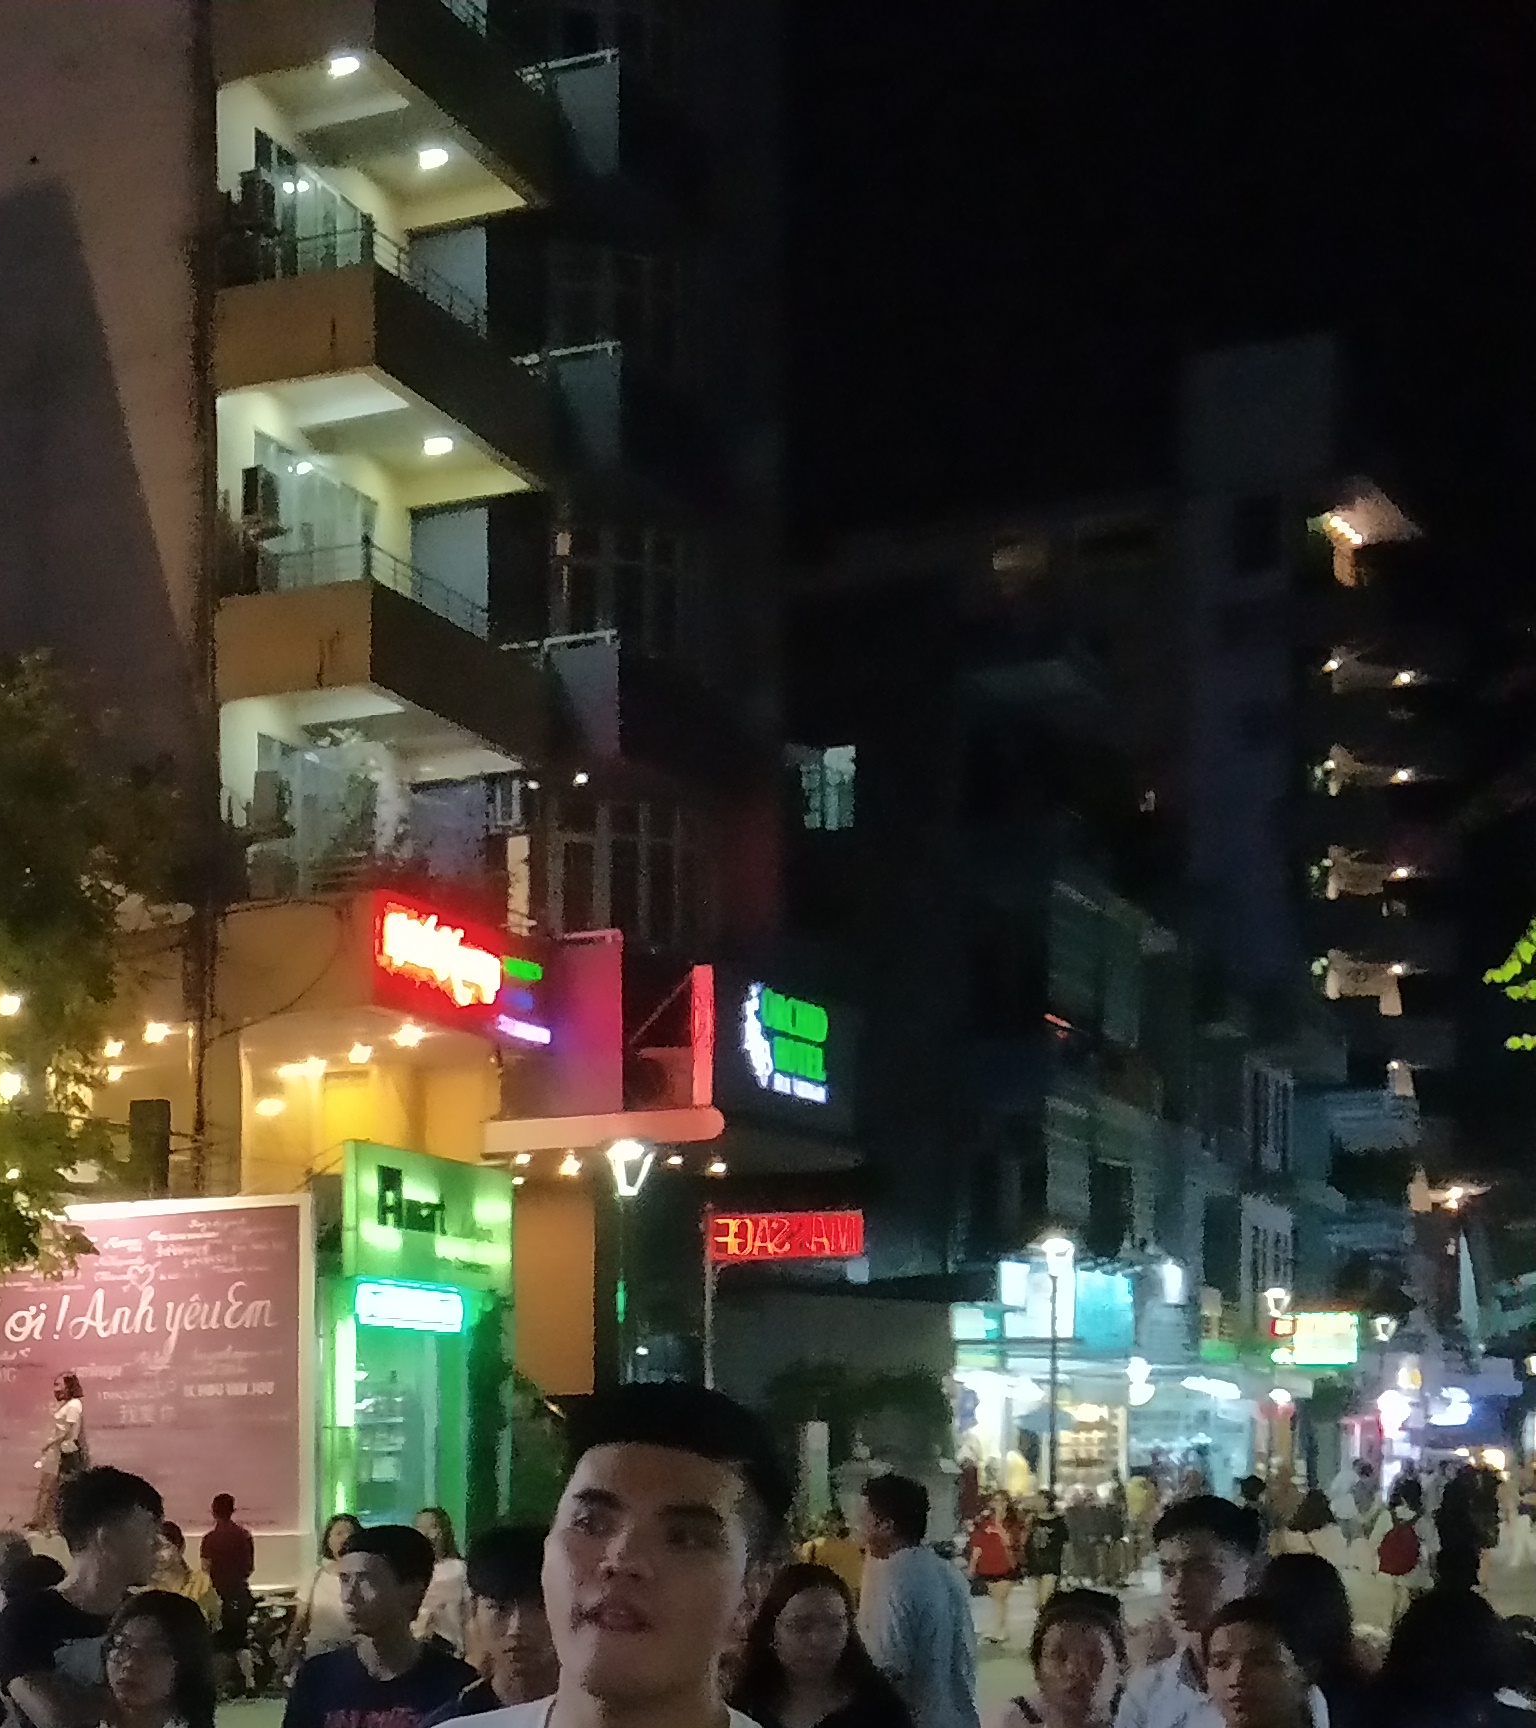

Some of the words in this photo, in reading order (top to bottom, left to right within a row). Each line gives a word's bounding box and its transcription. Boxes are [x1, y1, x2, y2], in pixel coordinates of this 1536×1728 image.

[69, 1284, 157, 1341] Anh
[165, 1293, 220, 1364] yêu
[223, 1280, 280, 1329] Em
